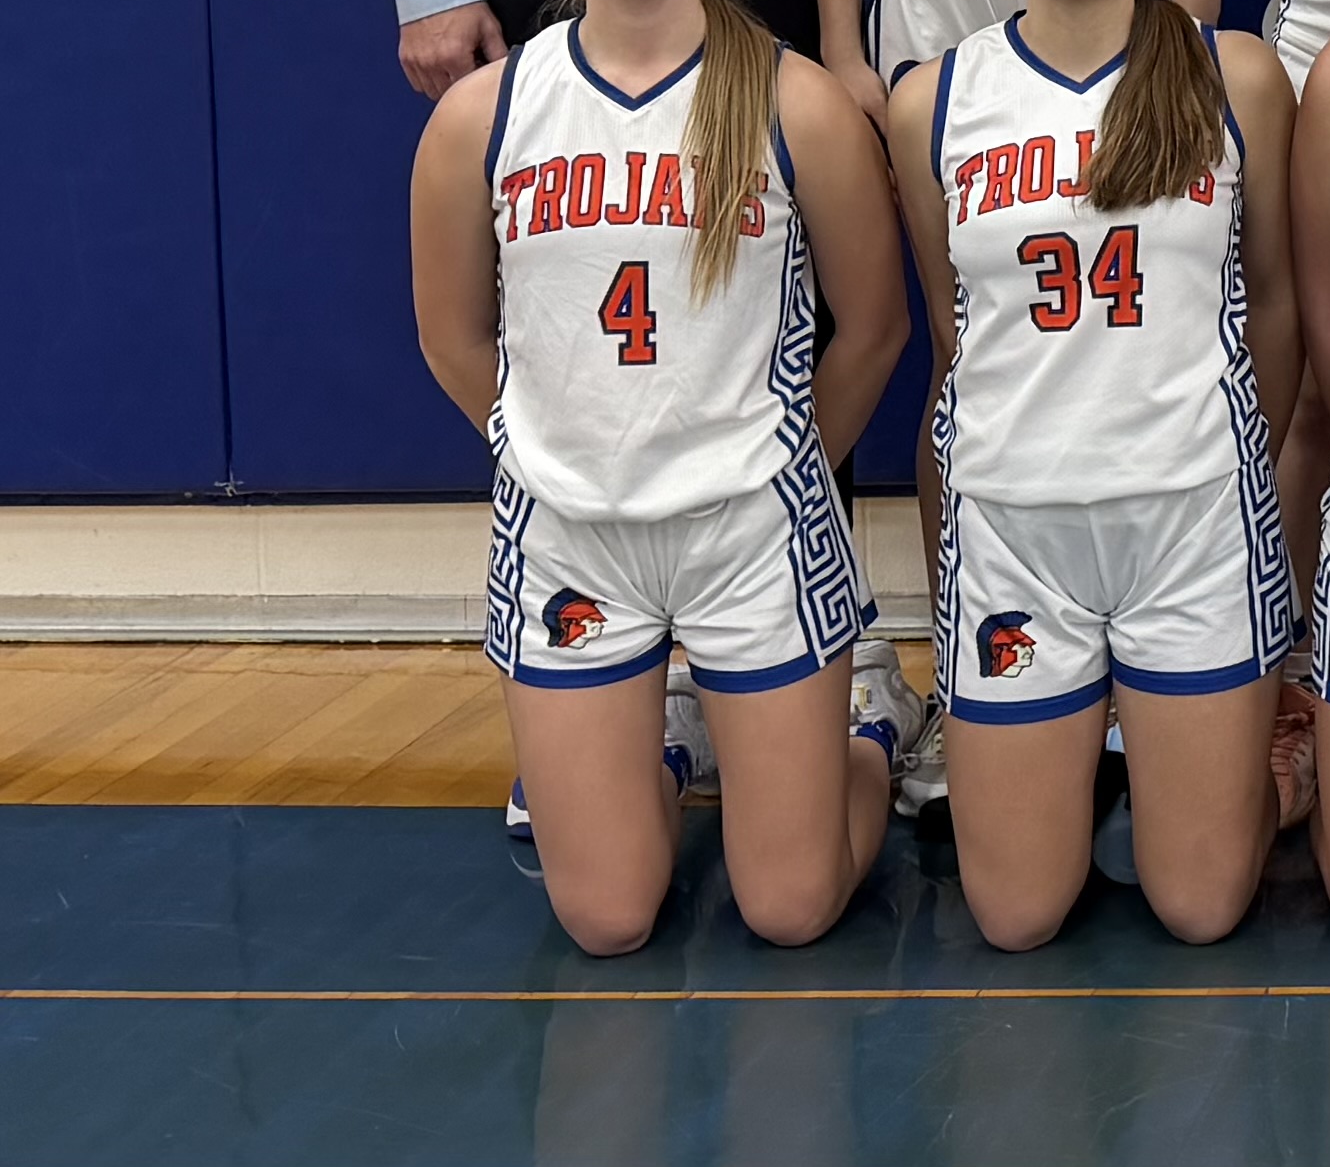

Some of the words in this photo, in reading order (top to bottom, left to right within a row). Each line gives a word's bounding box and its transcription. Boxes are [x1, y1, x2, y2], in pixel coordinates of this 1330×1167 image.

[955, 129, 1216, 226] TROJ
[597, 261, 657, 366] 4
[1017, 224, 1143, 333] 34
